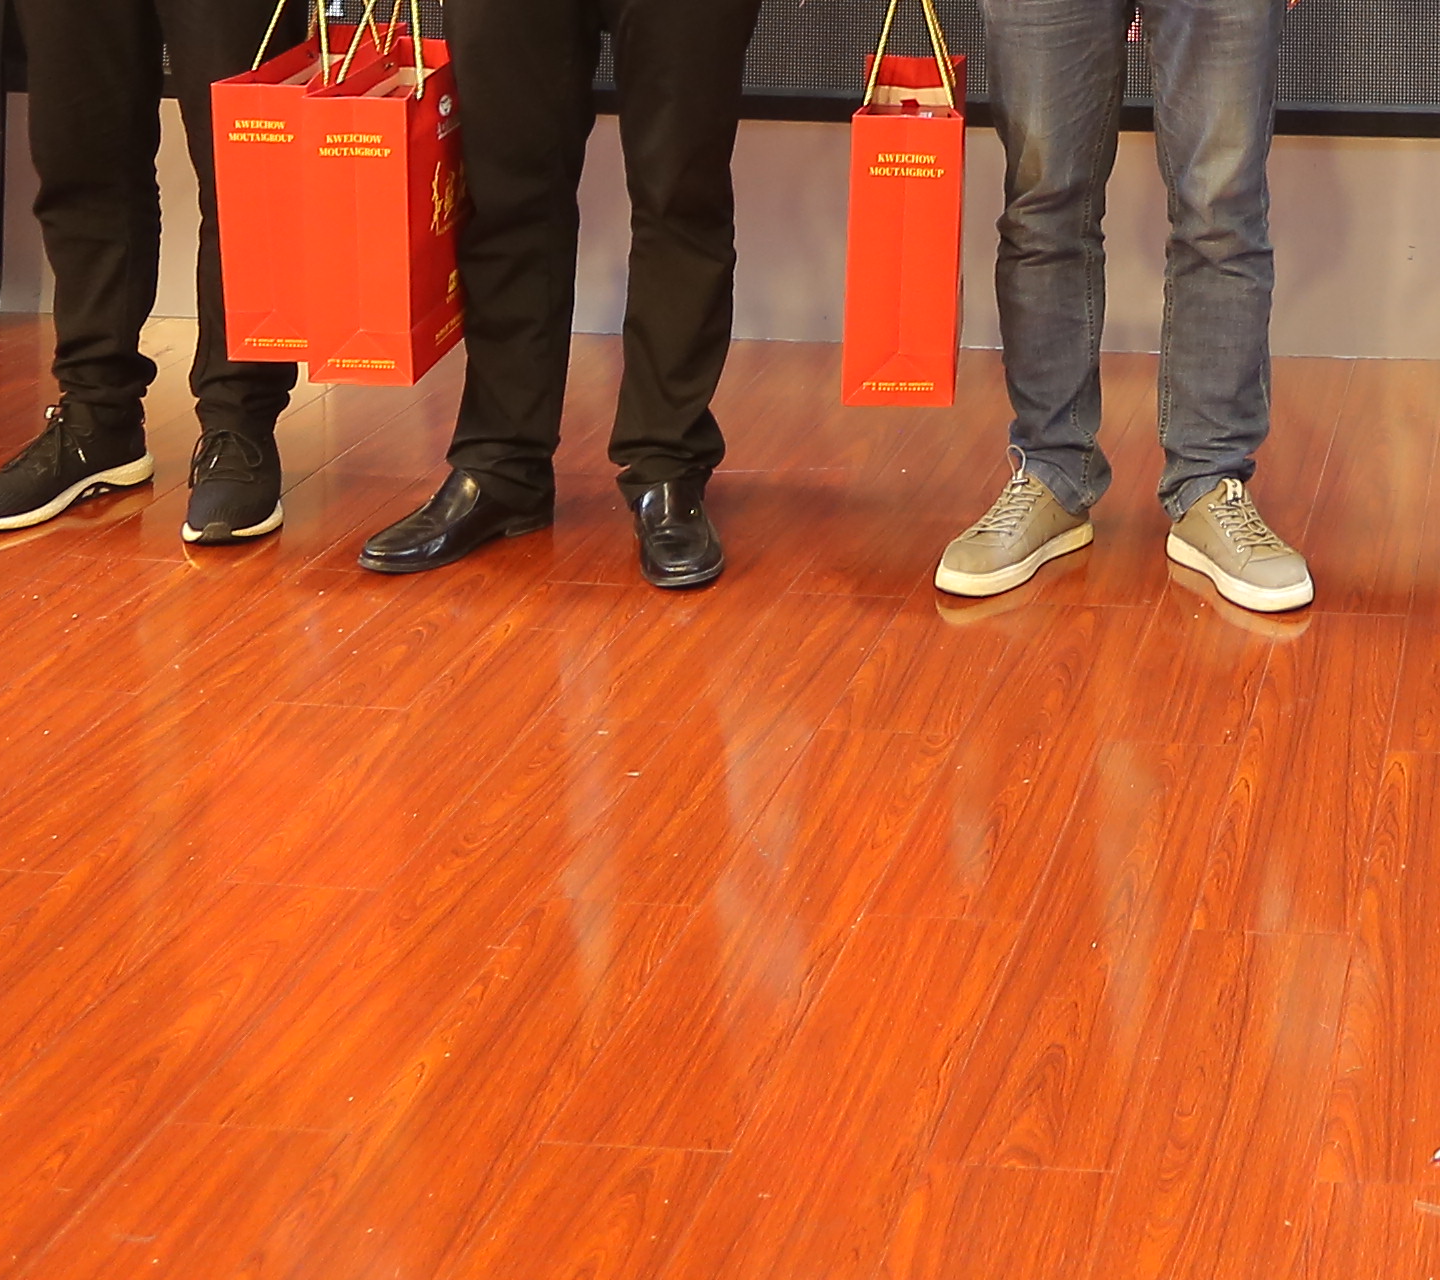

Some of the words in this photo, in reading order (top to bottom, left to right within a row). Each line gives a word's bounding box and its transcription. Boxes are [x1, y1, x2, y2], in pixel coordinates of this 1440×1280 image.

[234, 119, 287, 130] KWEICHOW
[325, 133, 383, 144] KWEICHOW
[877, 153, 937, 165] KWEICHOW
